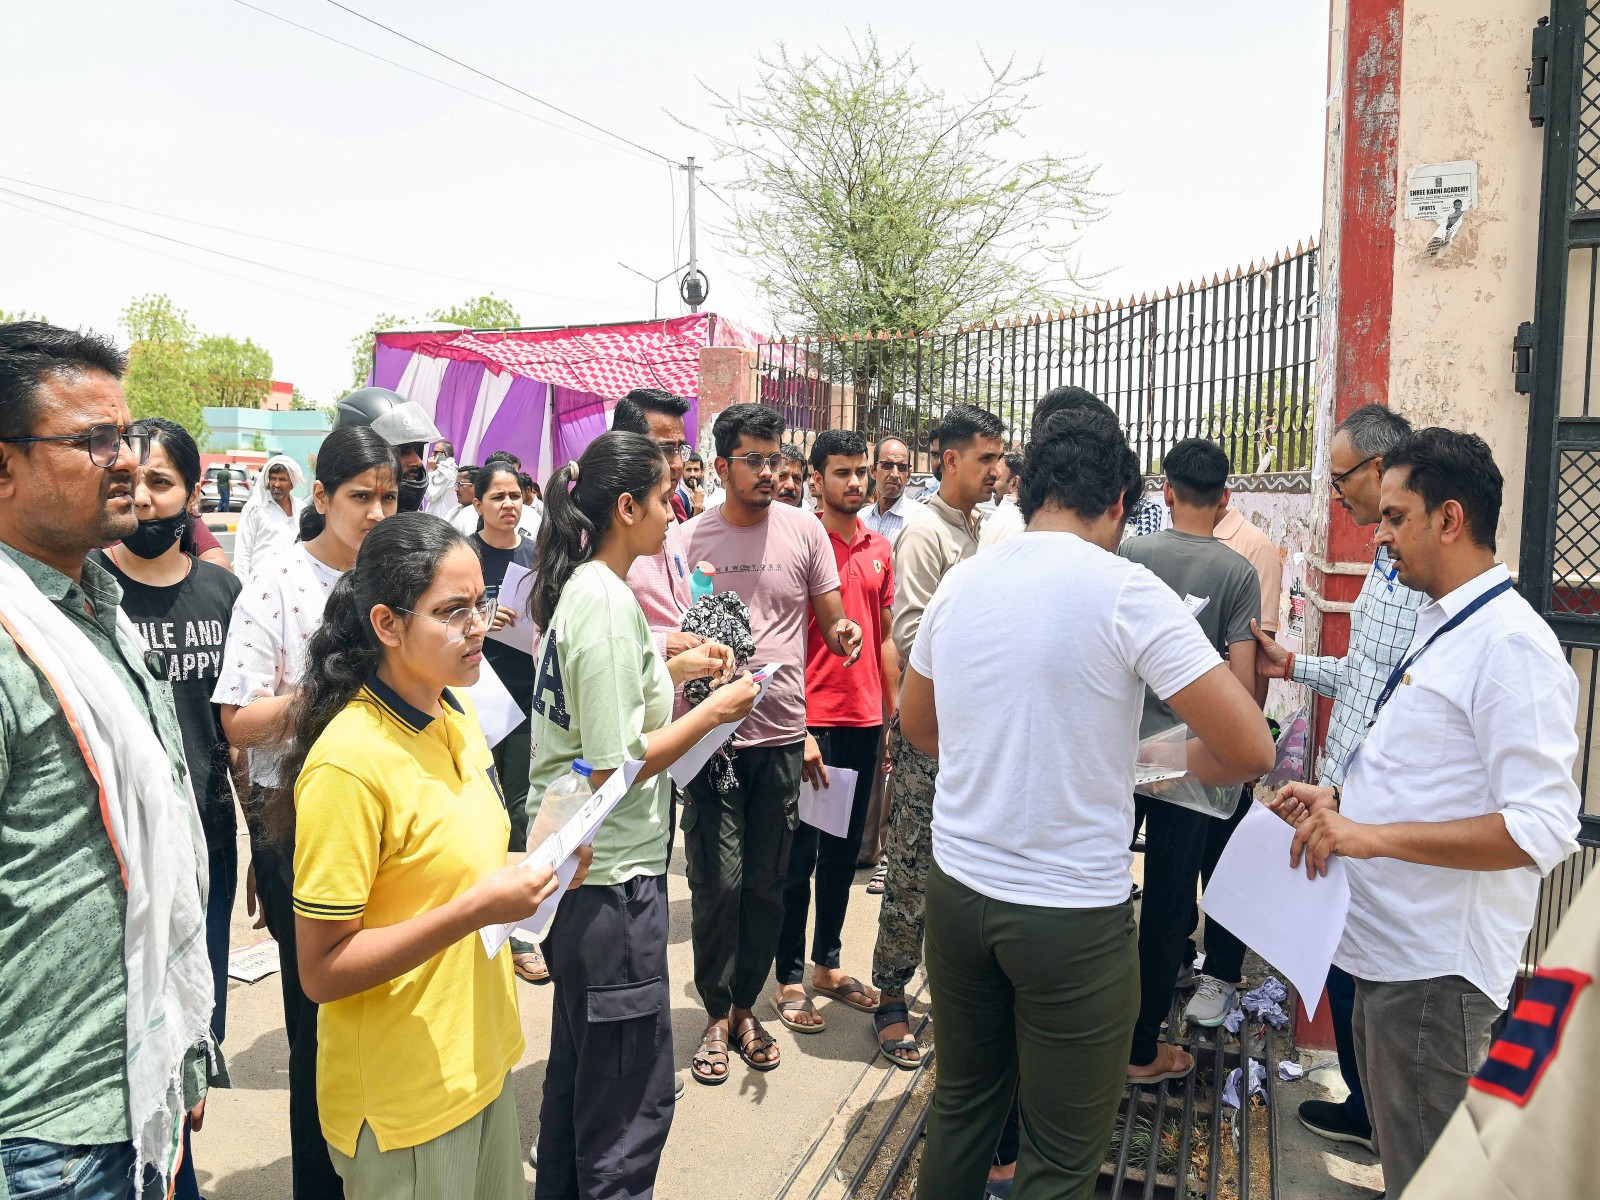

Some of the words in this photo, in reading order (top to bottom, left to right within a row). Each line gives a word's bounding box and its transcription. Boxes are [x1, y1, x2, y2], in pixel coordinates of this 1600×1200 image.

[1443, 185, 1469, 194] ACADEMY
[185, 620, 223, 648] AND
[167, 651, 221, 681] APPY
